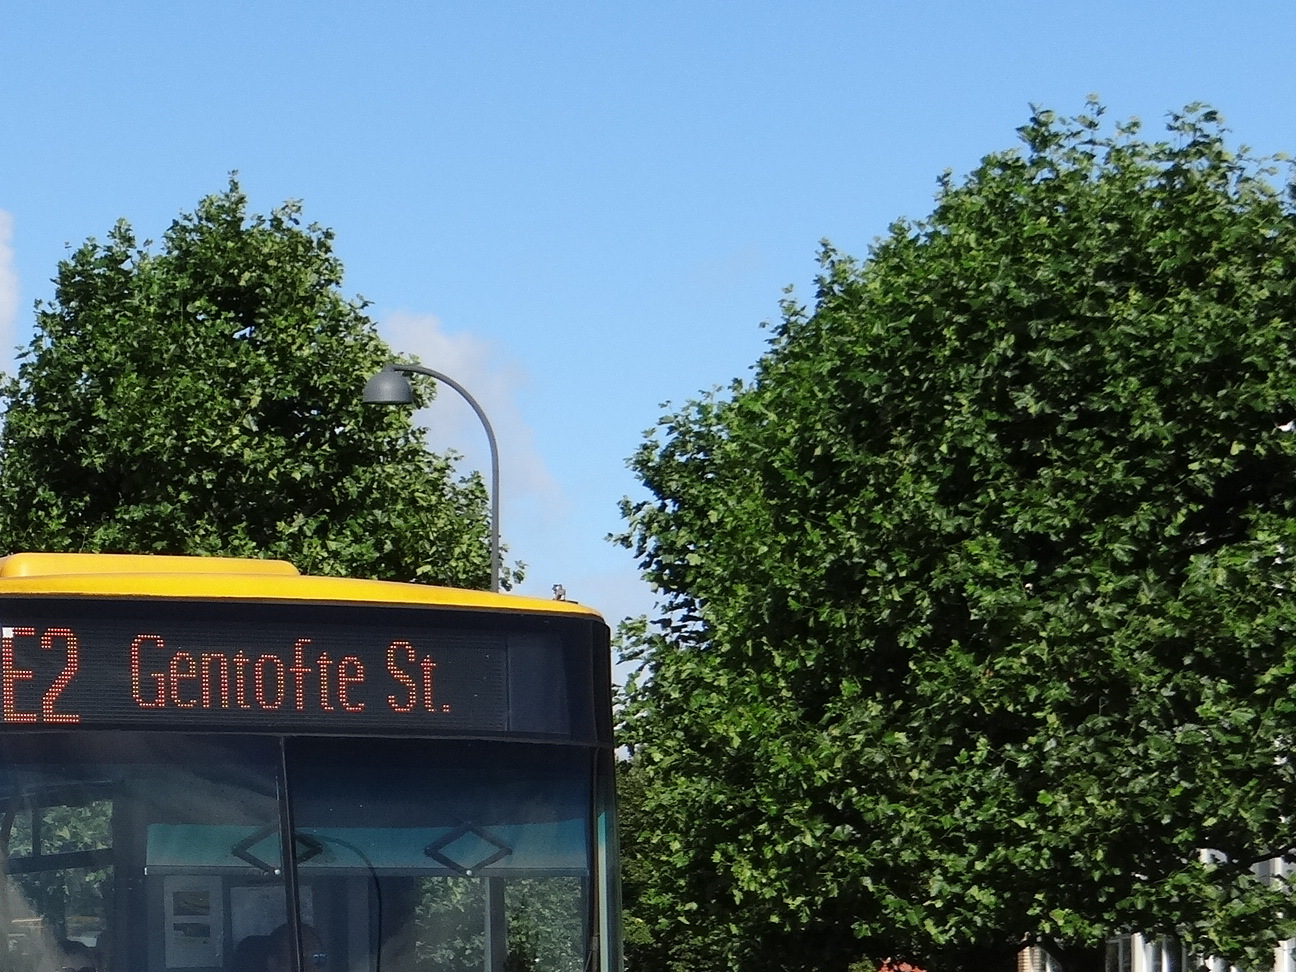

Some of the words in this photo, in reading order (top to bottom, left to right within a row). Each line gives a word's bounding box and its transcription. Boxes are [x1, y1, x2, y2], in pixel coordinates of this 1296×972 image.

[2, 626, 80, 724] E2
[130, 633, 366, 714] Gentofte
[386, 639, 451, 714] St.
